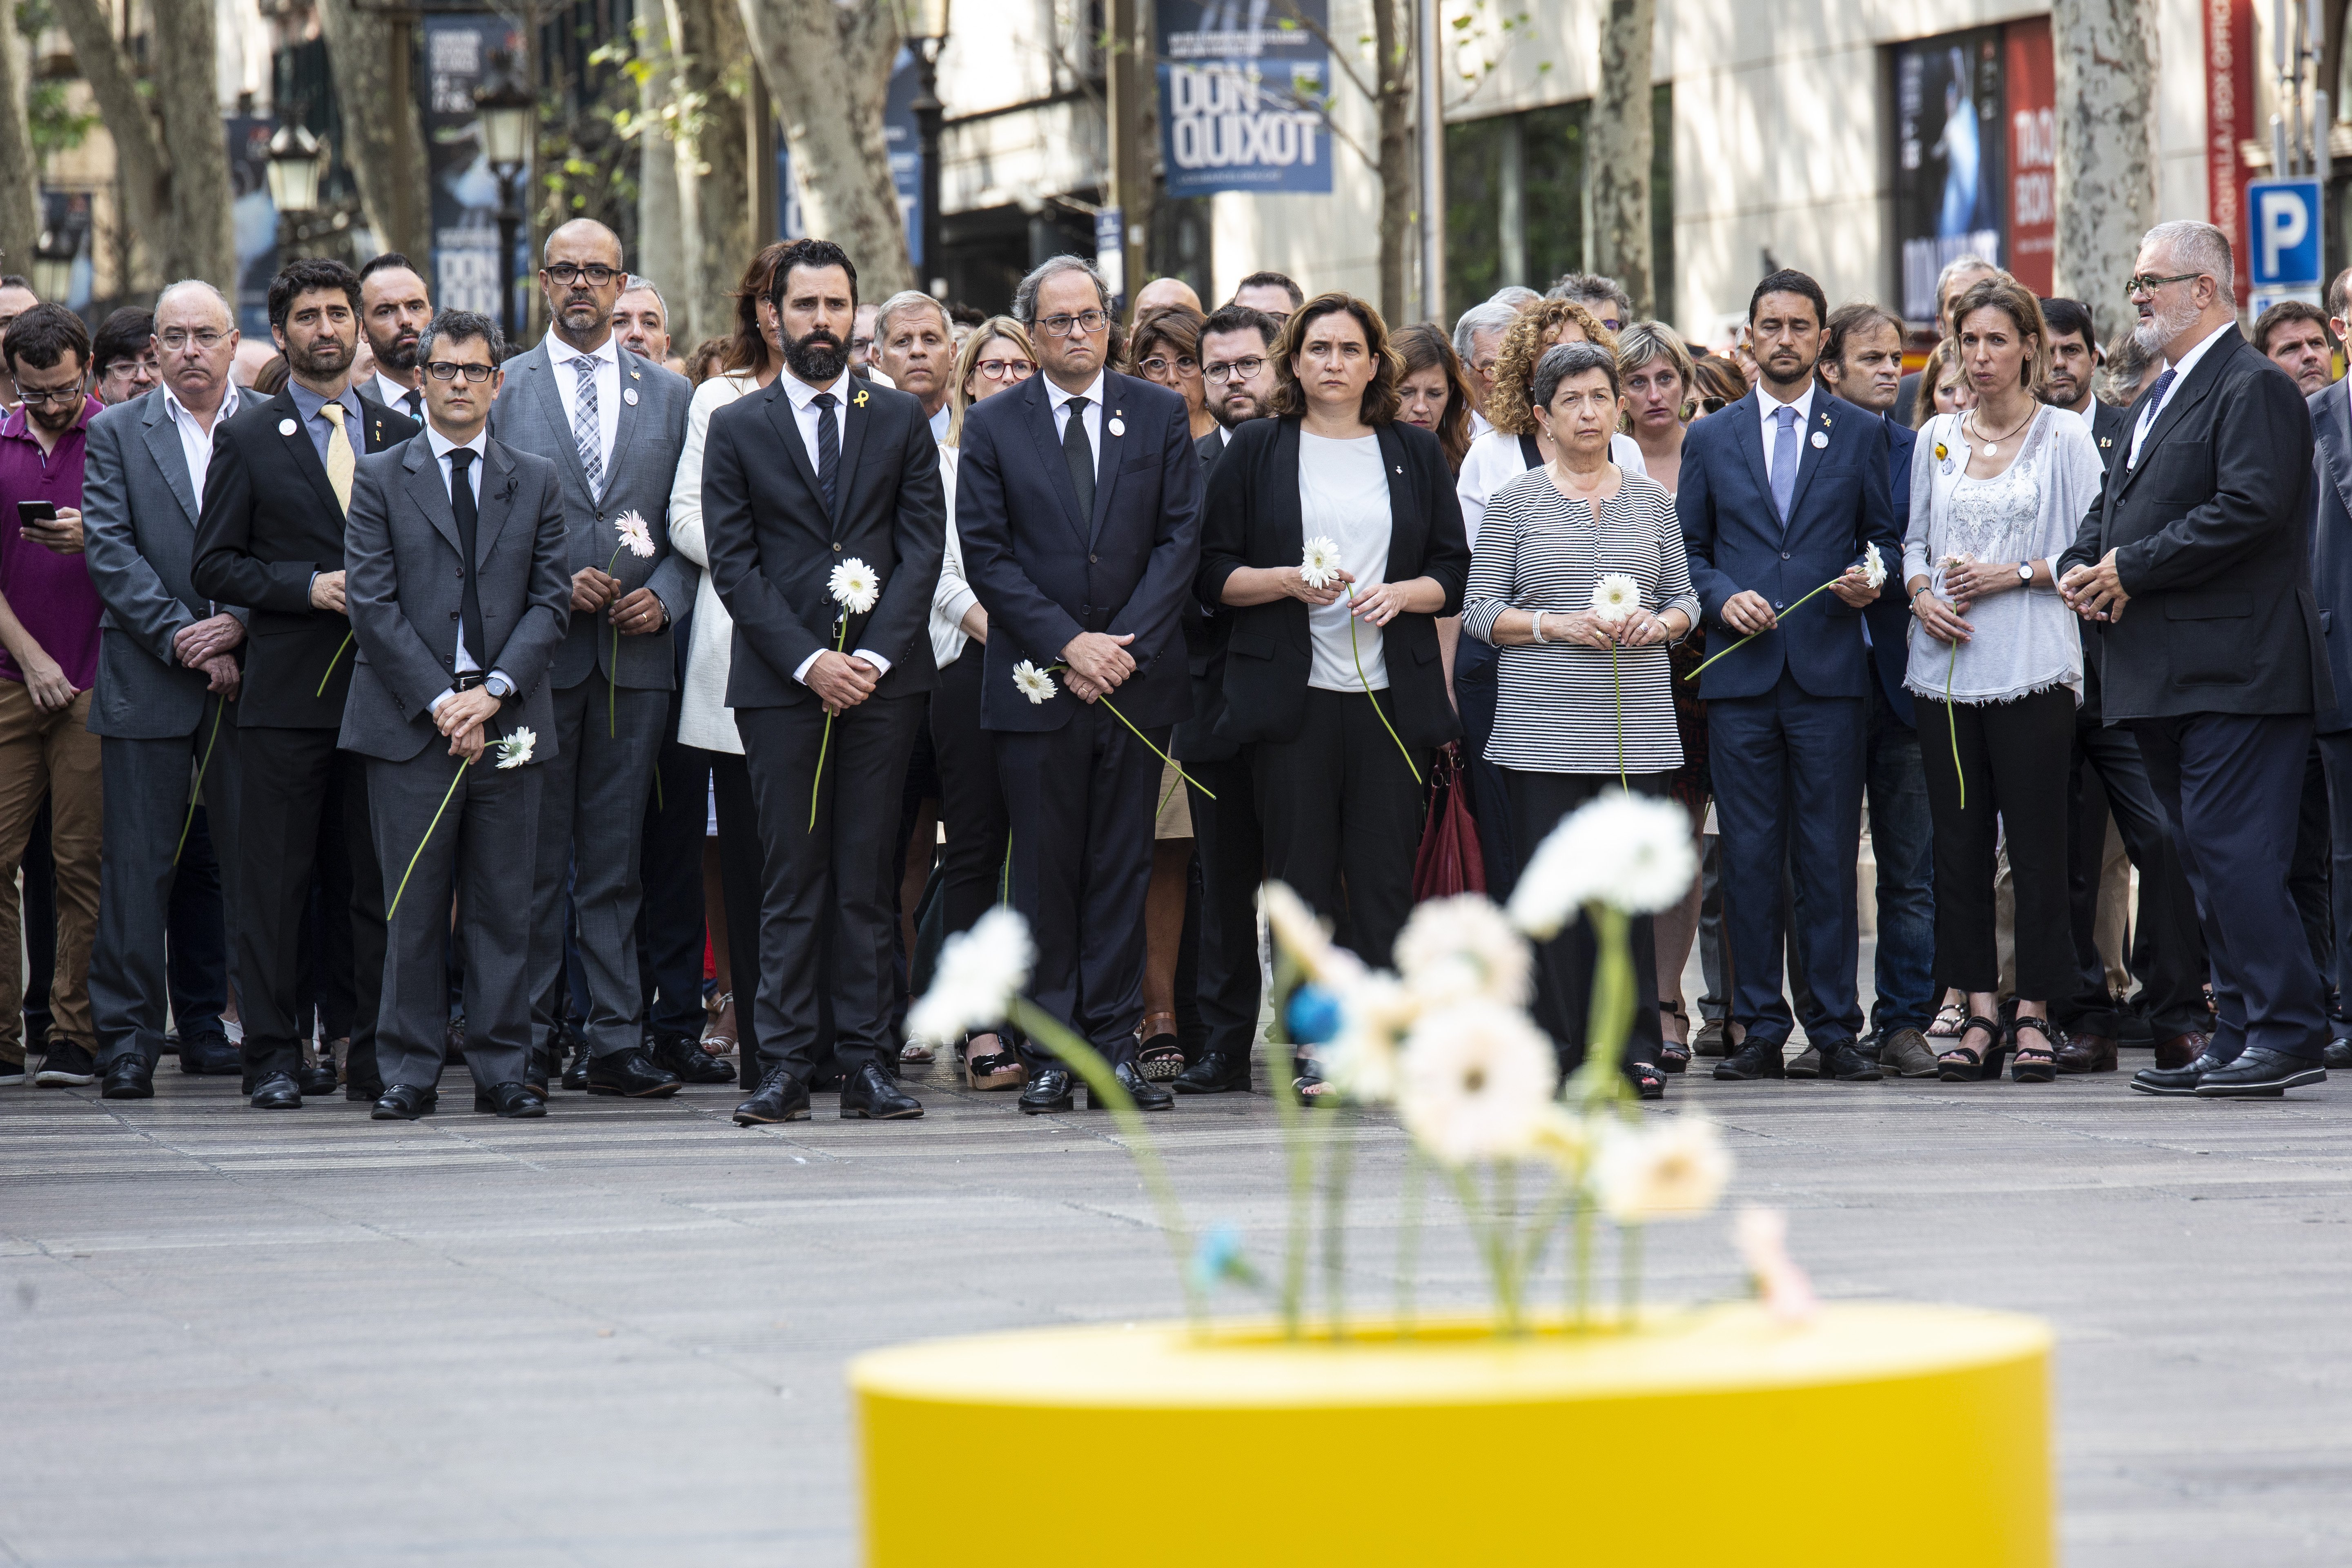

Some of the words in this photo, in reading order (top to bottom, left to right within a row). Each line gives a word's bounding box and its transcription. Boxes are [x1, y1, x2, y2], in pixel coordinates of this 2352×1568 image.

[1170, 62, 1260, 114] DON
[1172, 110, 1322, 168] QUIXOT
[2261, 190, 2307, 277] P
